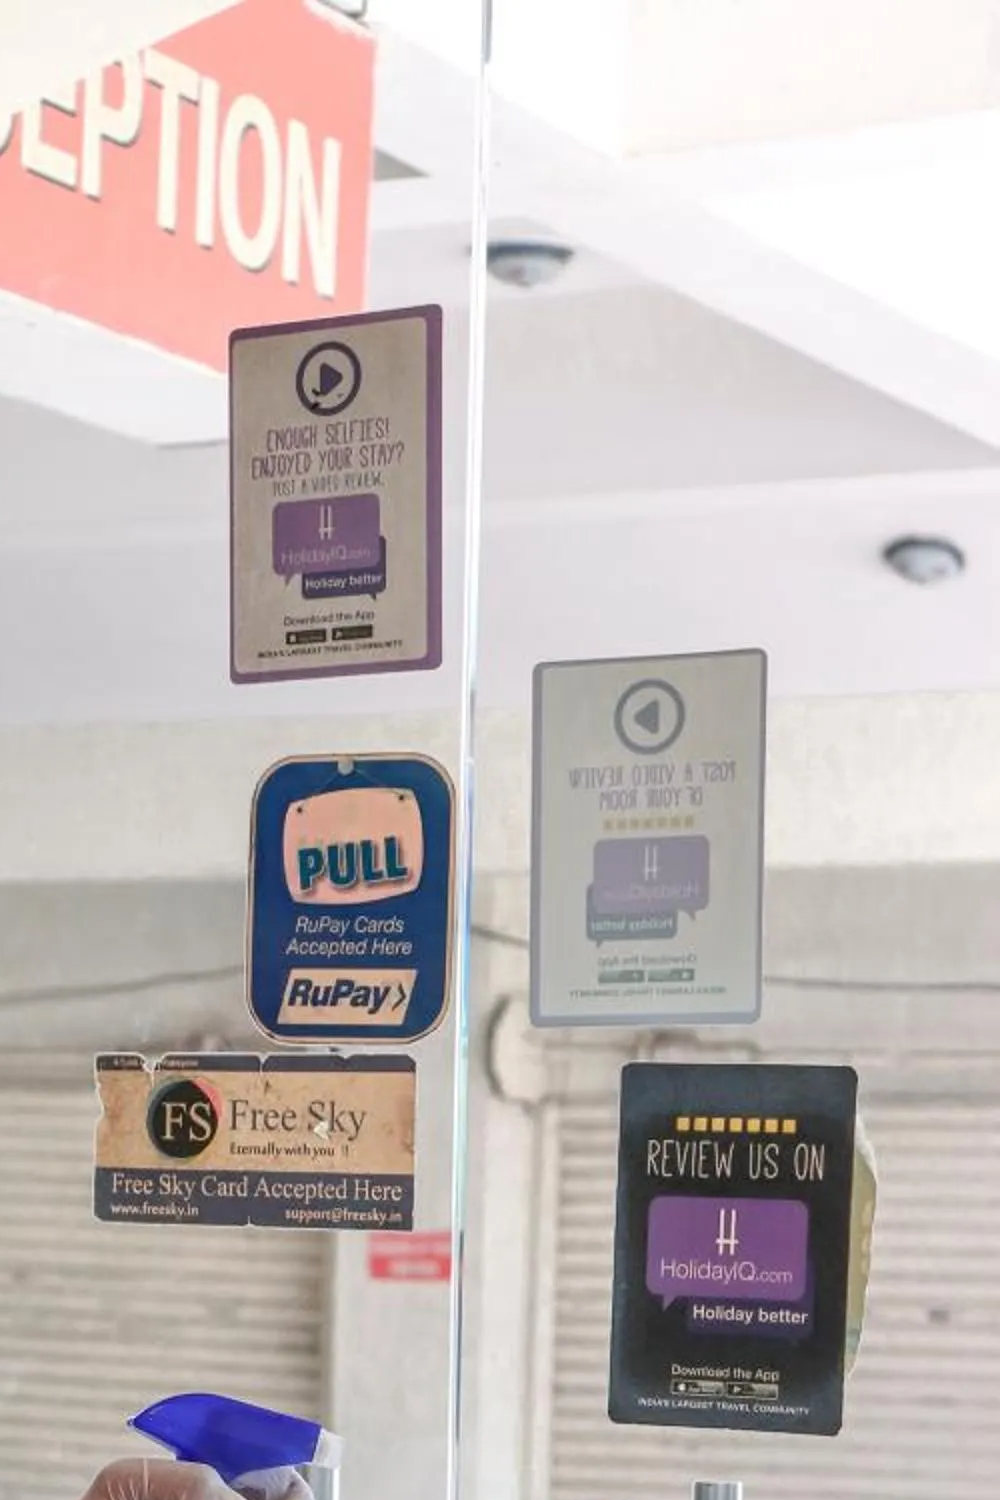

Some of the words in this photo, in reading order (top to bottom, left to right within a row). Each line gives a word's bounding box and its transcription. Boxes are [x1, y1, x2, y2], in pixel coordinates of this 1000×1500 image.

[266, 424, 318, 453] ENOUGH
[325, 416, 390, 446] SELFIES!
[251, 451, 313, 480] ENJOYED
[318, 446, 353, 473] YOUR
[358, 439, 405, 468] STAY?
[305, 576, 346, 591] Holiday
[349, 573, 383, 586] better
[296, 836, 409, 892] PULL
[295, 915, 351, 937] RuPay
[354, 915, 405, 934] Cards
[285, 938, 369, 959] Accepted
[371, 938, 413, 956] Here
[287, 979, 391, 1015] RuPay
[160, 1101, 212, 1142] FS
[228, 1099, 298, 1132] Free
[307, 1100, 367, 1141] Sky
[283, 1143, 311, 1157] with
[312, 1146, 335, 1161] you
[646, 1138, 735, 1180] REVIEW
[749, 1143, 780, 1180] US
[793, 1143, 825, 1182] ON
[112, 1172, 154, 1195] Free
[159, 1173, 197, 1202] Sky
[201, 1174, 250, 1198] Card
[253, 1176, 349, 1205] Accepted
[353, 1178, 403, 1202] Here
[110, 1200, 200, 1220] www.freesky.in
[284, 1207, 403, 1226] support@freesky.in
[660, 1257, 794, 1286] HolidayIQ.com
[693, 1303, 753, 1326] Holiday
[758, 1307, 809, 1325] better
[671, 1363, 731, 1379] Download
[733, 1366, 752, 1380] the
[754, 1368, 780, 1383] App
[715, 1400, 750, 1413] TRAVEL
[752, 1402, 811, 1416] COMMUNITY
